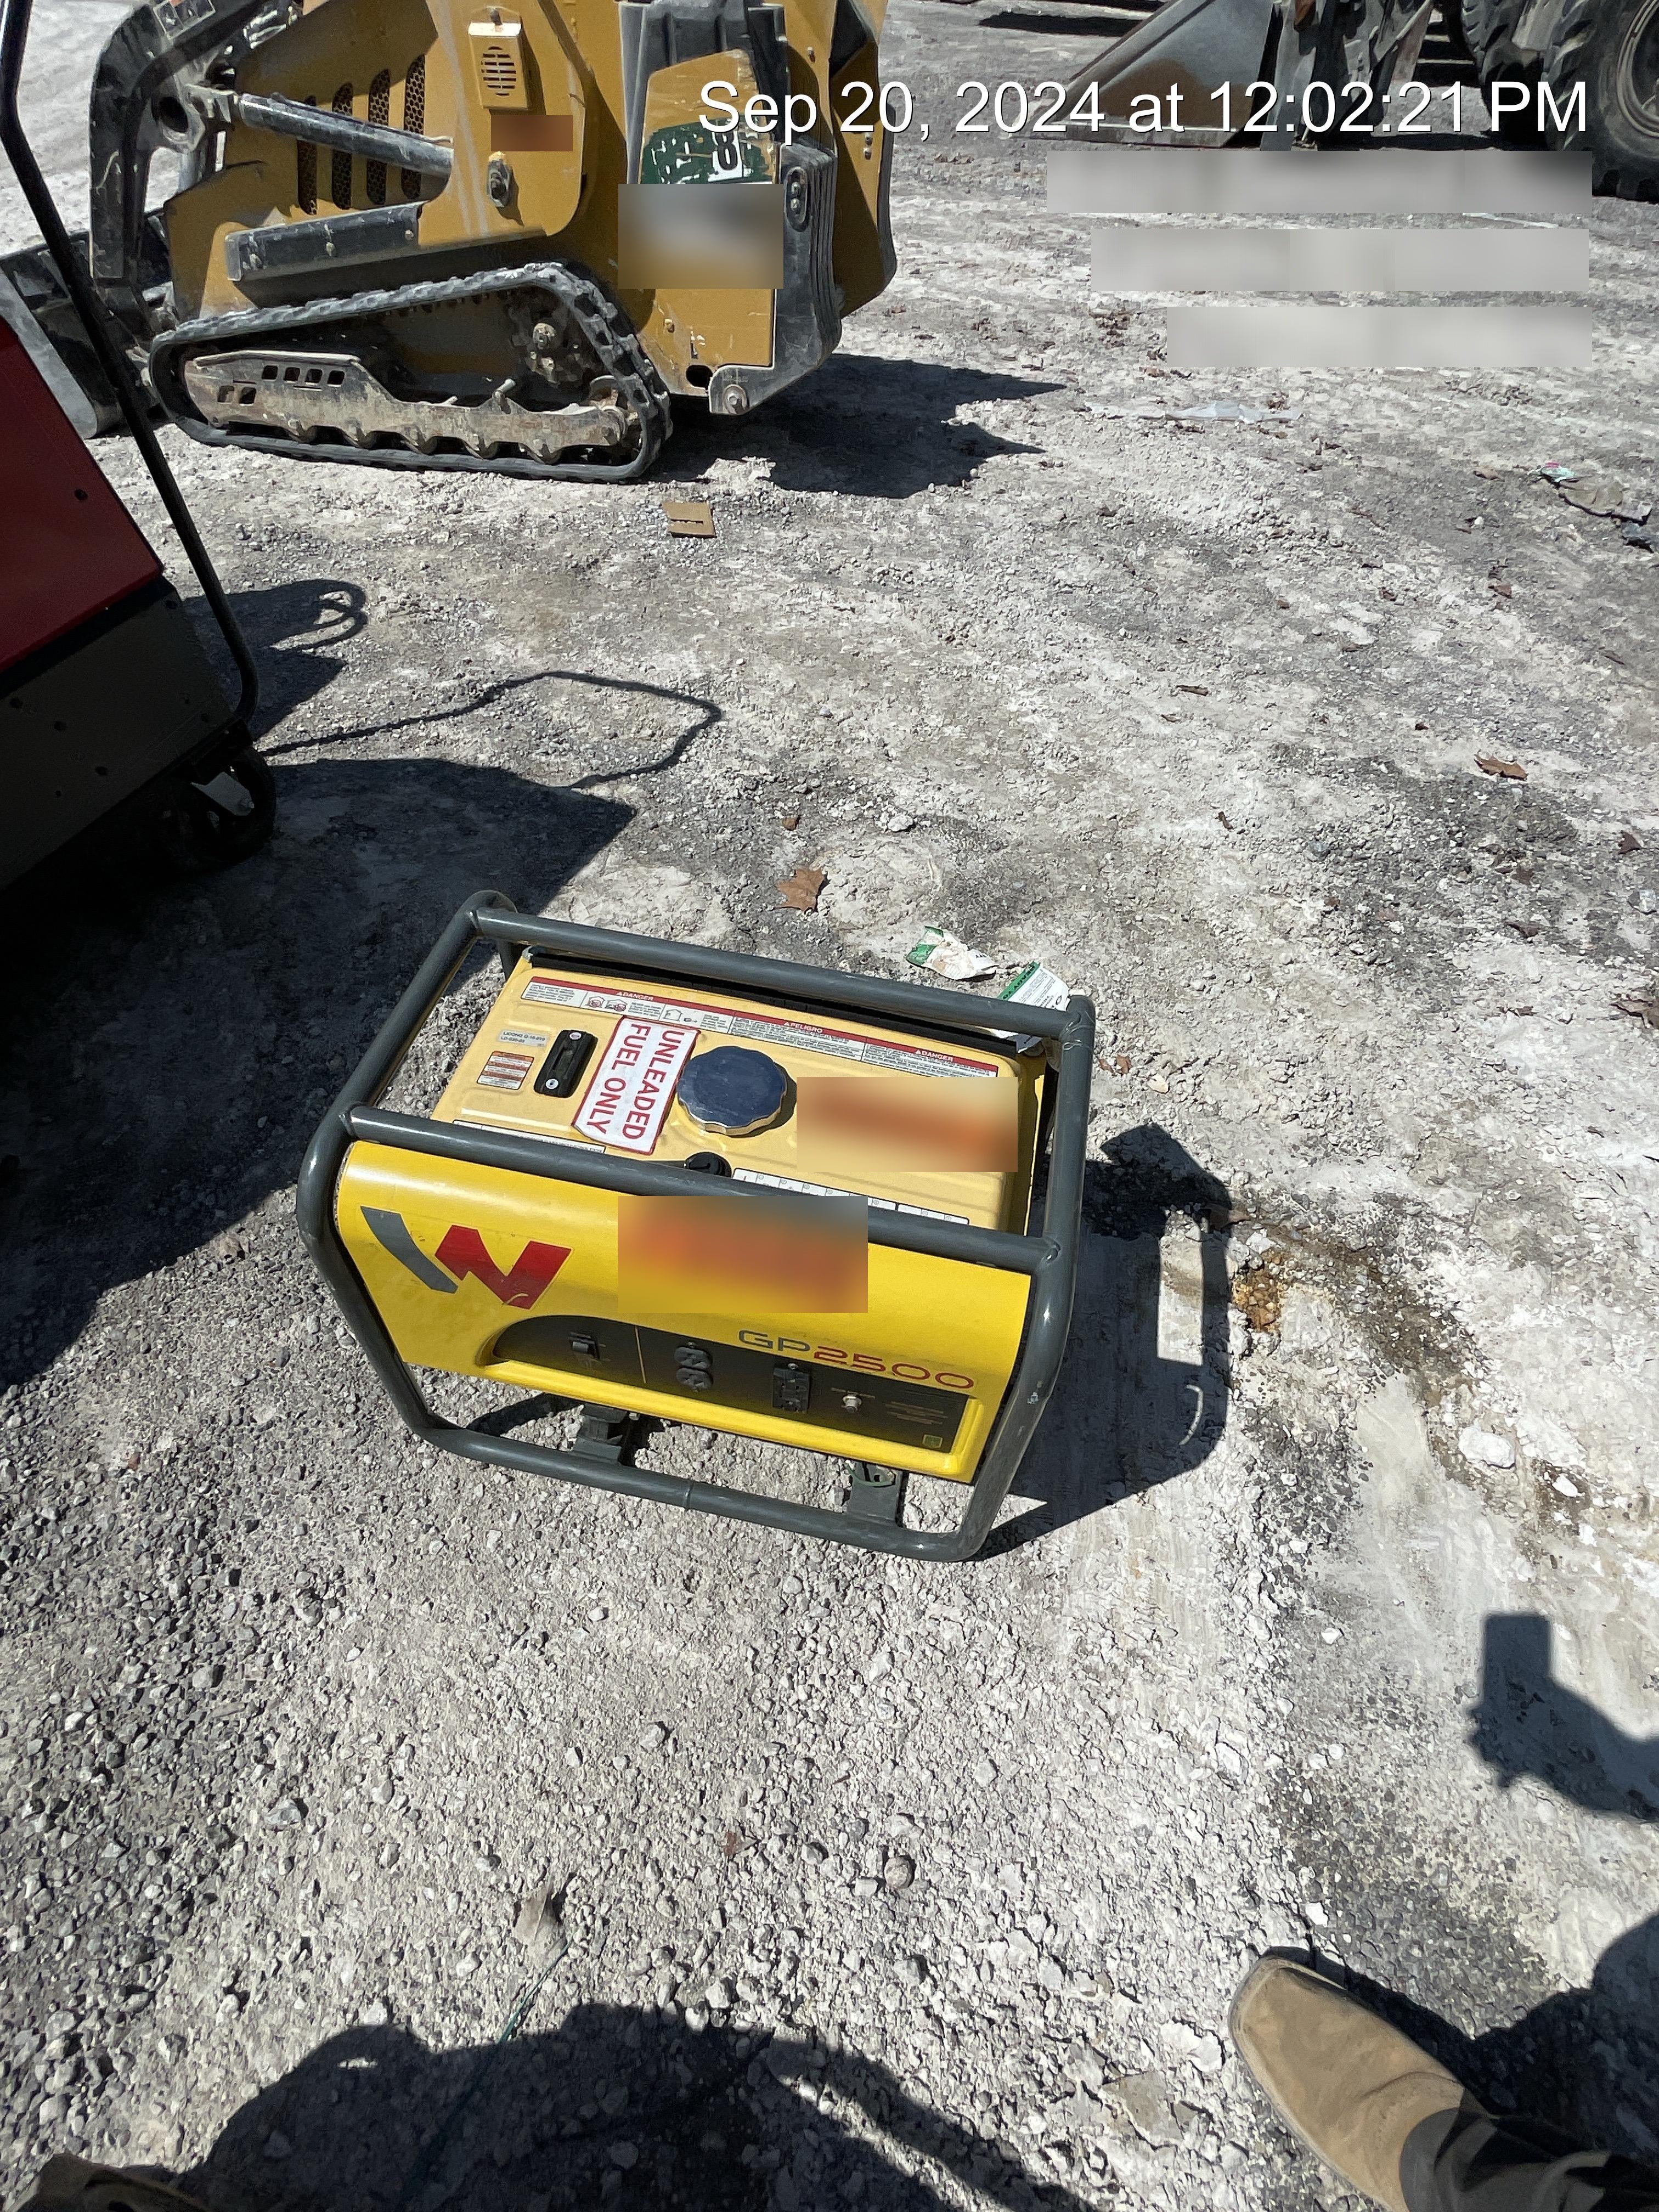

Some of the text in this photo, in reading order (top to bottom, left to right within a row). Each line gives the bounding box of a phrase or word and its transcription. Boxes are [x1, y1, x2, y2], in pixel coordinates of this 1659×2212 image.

[623, 991, 654, 1001] DANGER
[611, 1024, 652, 1070] FUEL
[790, 1022, 823, 1034] PELIGRO
[922, 1050, 953, 1062] DANGER
[586, 1077, 627, 1135] ONLY
[622, 1030, 685, 1139] UNLEADED
[738, 1329, 975, 1389] GP2500
